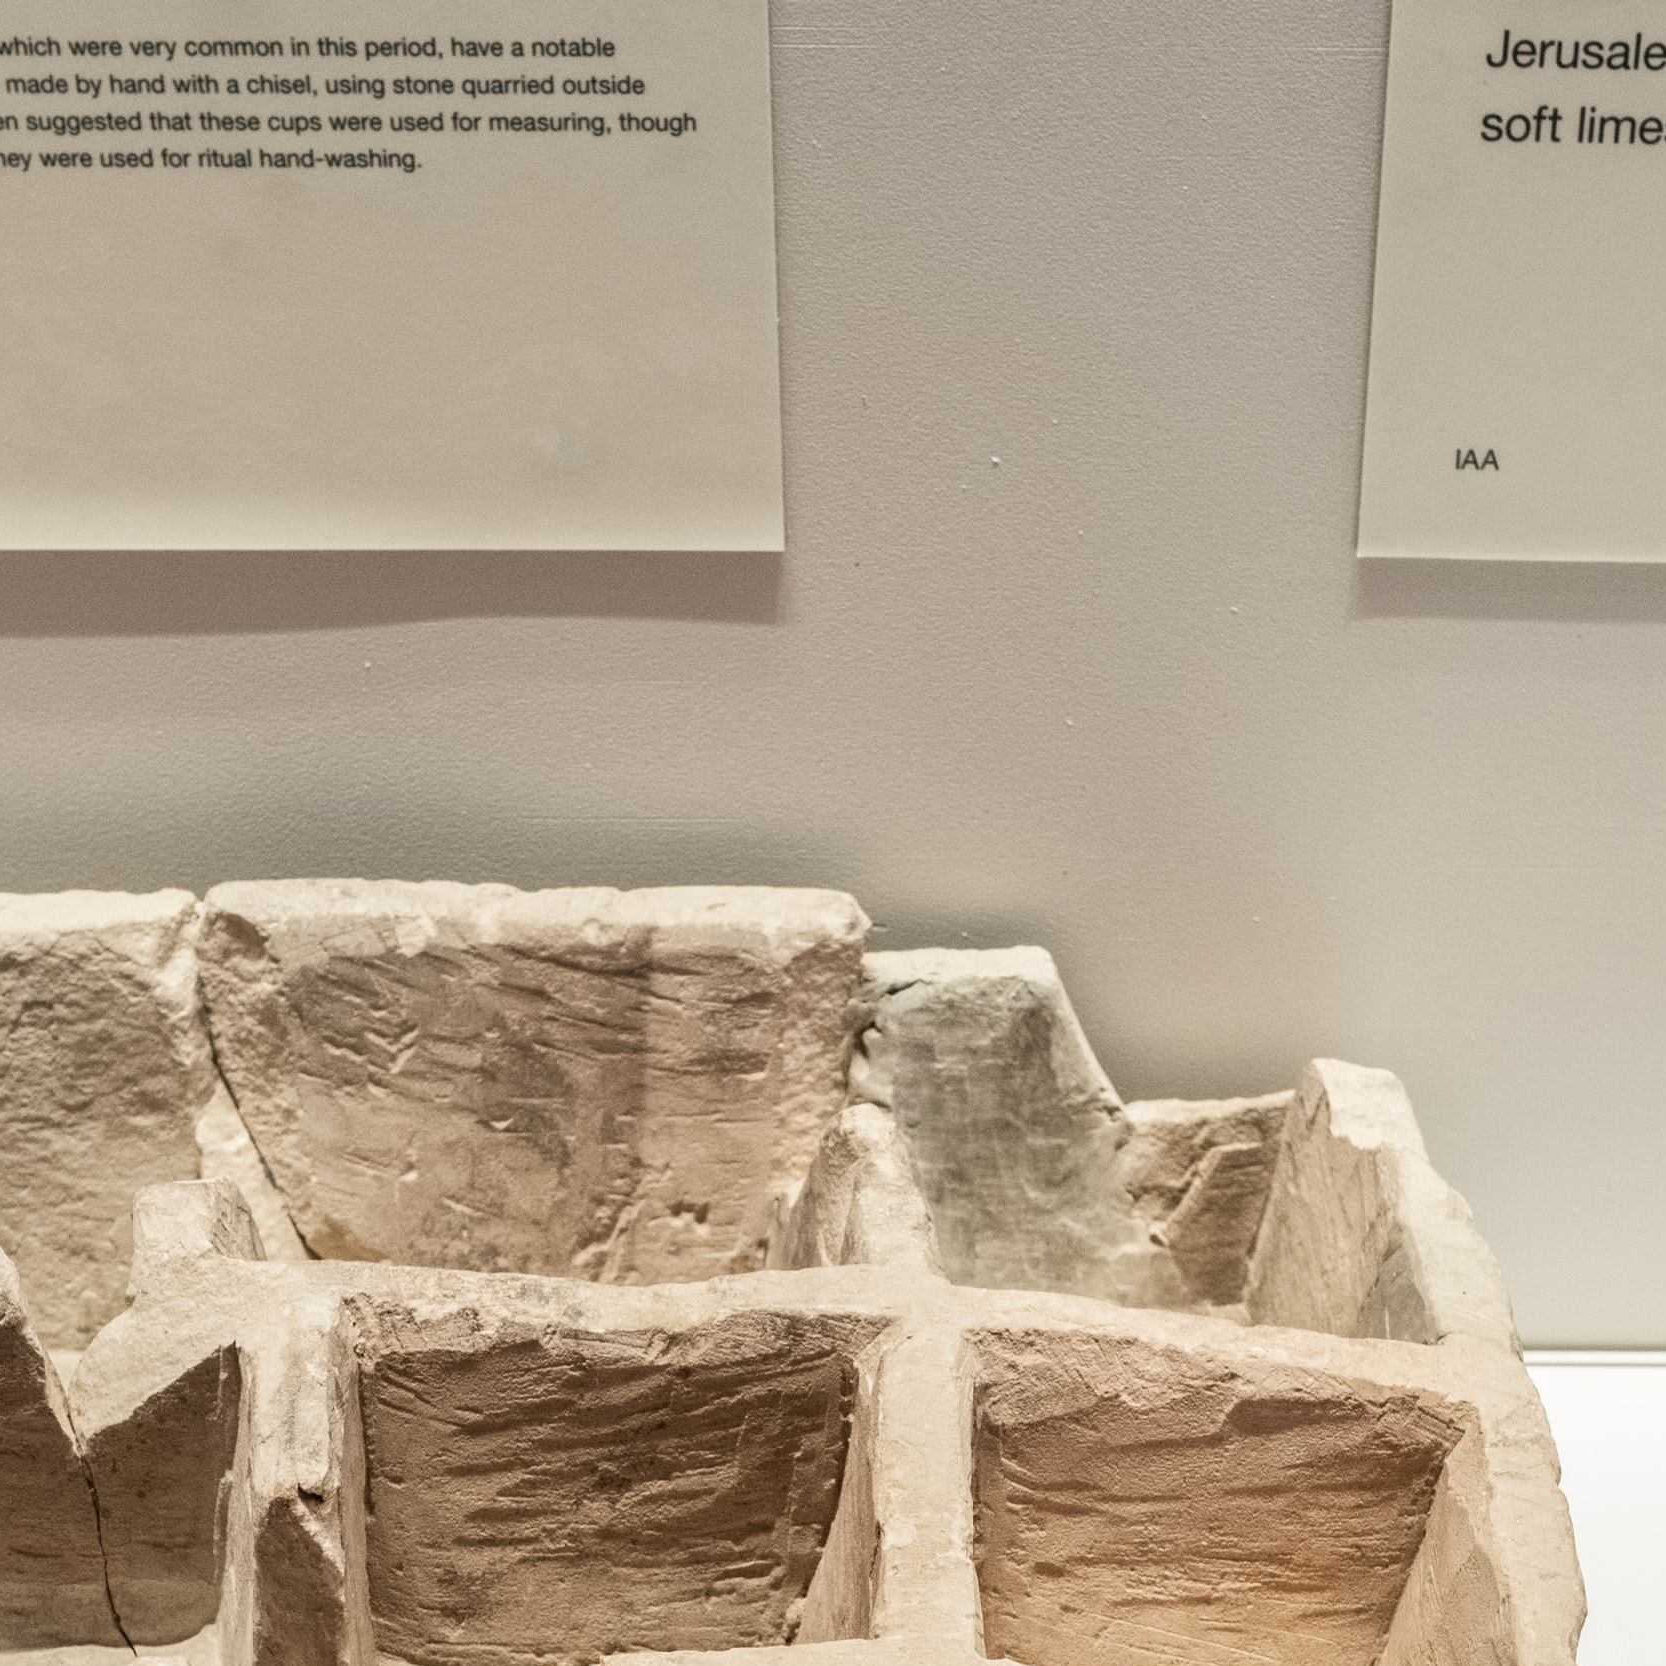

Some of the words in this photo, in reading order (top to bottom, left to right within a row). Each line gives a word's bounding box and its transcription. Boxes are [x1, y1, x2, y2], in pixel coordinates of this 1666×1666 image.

[67, 38, 124, 58] were
[128, 38, 178, 62] very
[183, 39, 285, 59] common
[289, 36, 311, 58] in
[316, 36, 359, 59] this
[363, 35, 444, 63] period,
[449, 35, 505, 59] have
[510, 39, 526, 59] a
[530, 35, 617, 59] notable
[4, 73, 70, 96] made
[74, 73, 103, 100] by
[108, 73, 167, 96] hand
[171, 73, 220, 95] with
[225, 77, 241, 96] a
[245, 73, 319, 98] chisel,
[324, 73, 387, 101] using
[391, 74, 456, 96] stone
[460, 73, 556, 100] quarried
[561, 73, 646, 96] outside
[25, 110, 143, 138] suggested
[148, 110, 194, 133] that
[197, 110, 262, 133] these
[266, 114, 323, 137] cups
[327, 114, 384, 134] were
[389, 111, 445, 134] used
[450, 110, 483, 134] for
[487, 111, 612, 138] measuring,
[617, 110, 698, 139] though
[1480, 103, 1563, 144] soft
[38, 150, 94, 170] were
[98, 147, 155, 170] used
[159, 146, 192, 170] for
[197, 147, 253, 170] ritual
[258, 147, 423, 175] hand-washing.
[1454, 447, 1500, 472] IAA
